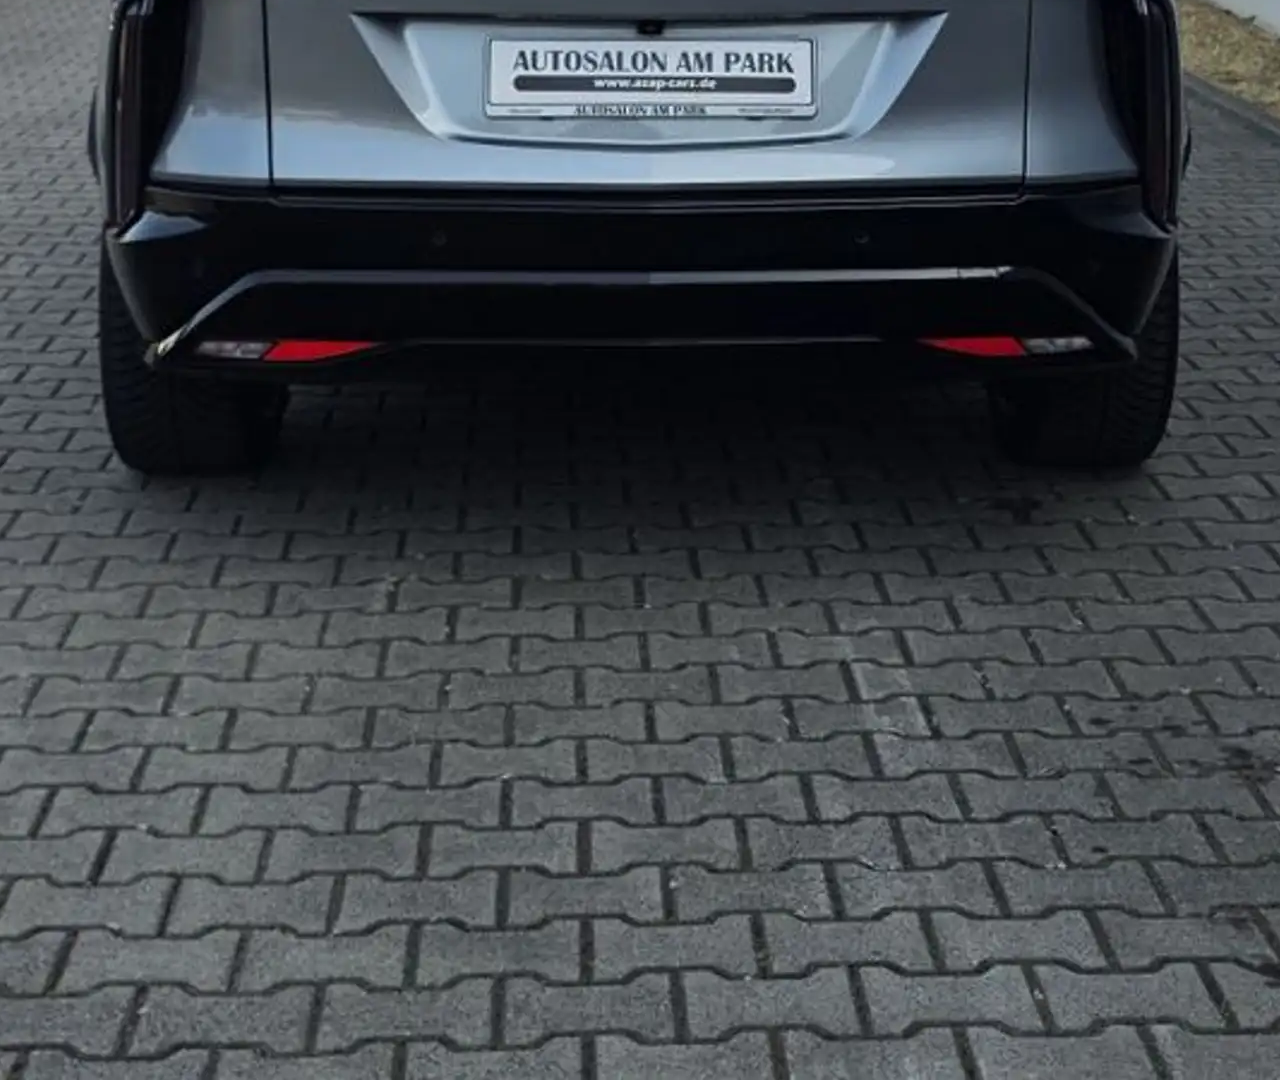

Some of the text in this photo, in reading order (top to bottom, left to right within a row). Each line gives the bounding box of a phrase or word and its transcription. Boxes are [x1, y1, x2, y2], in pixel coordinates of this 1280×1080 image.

[514, 50, 796, 73] AUTOSALON AM PARK
[593, 77, 717, 91] www.asap-cars.de
